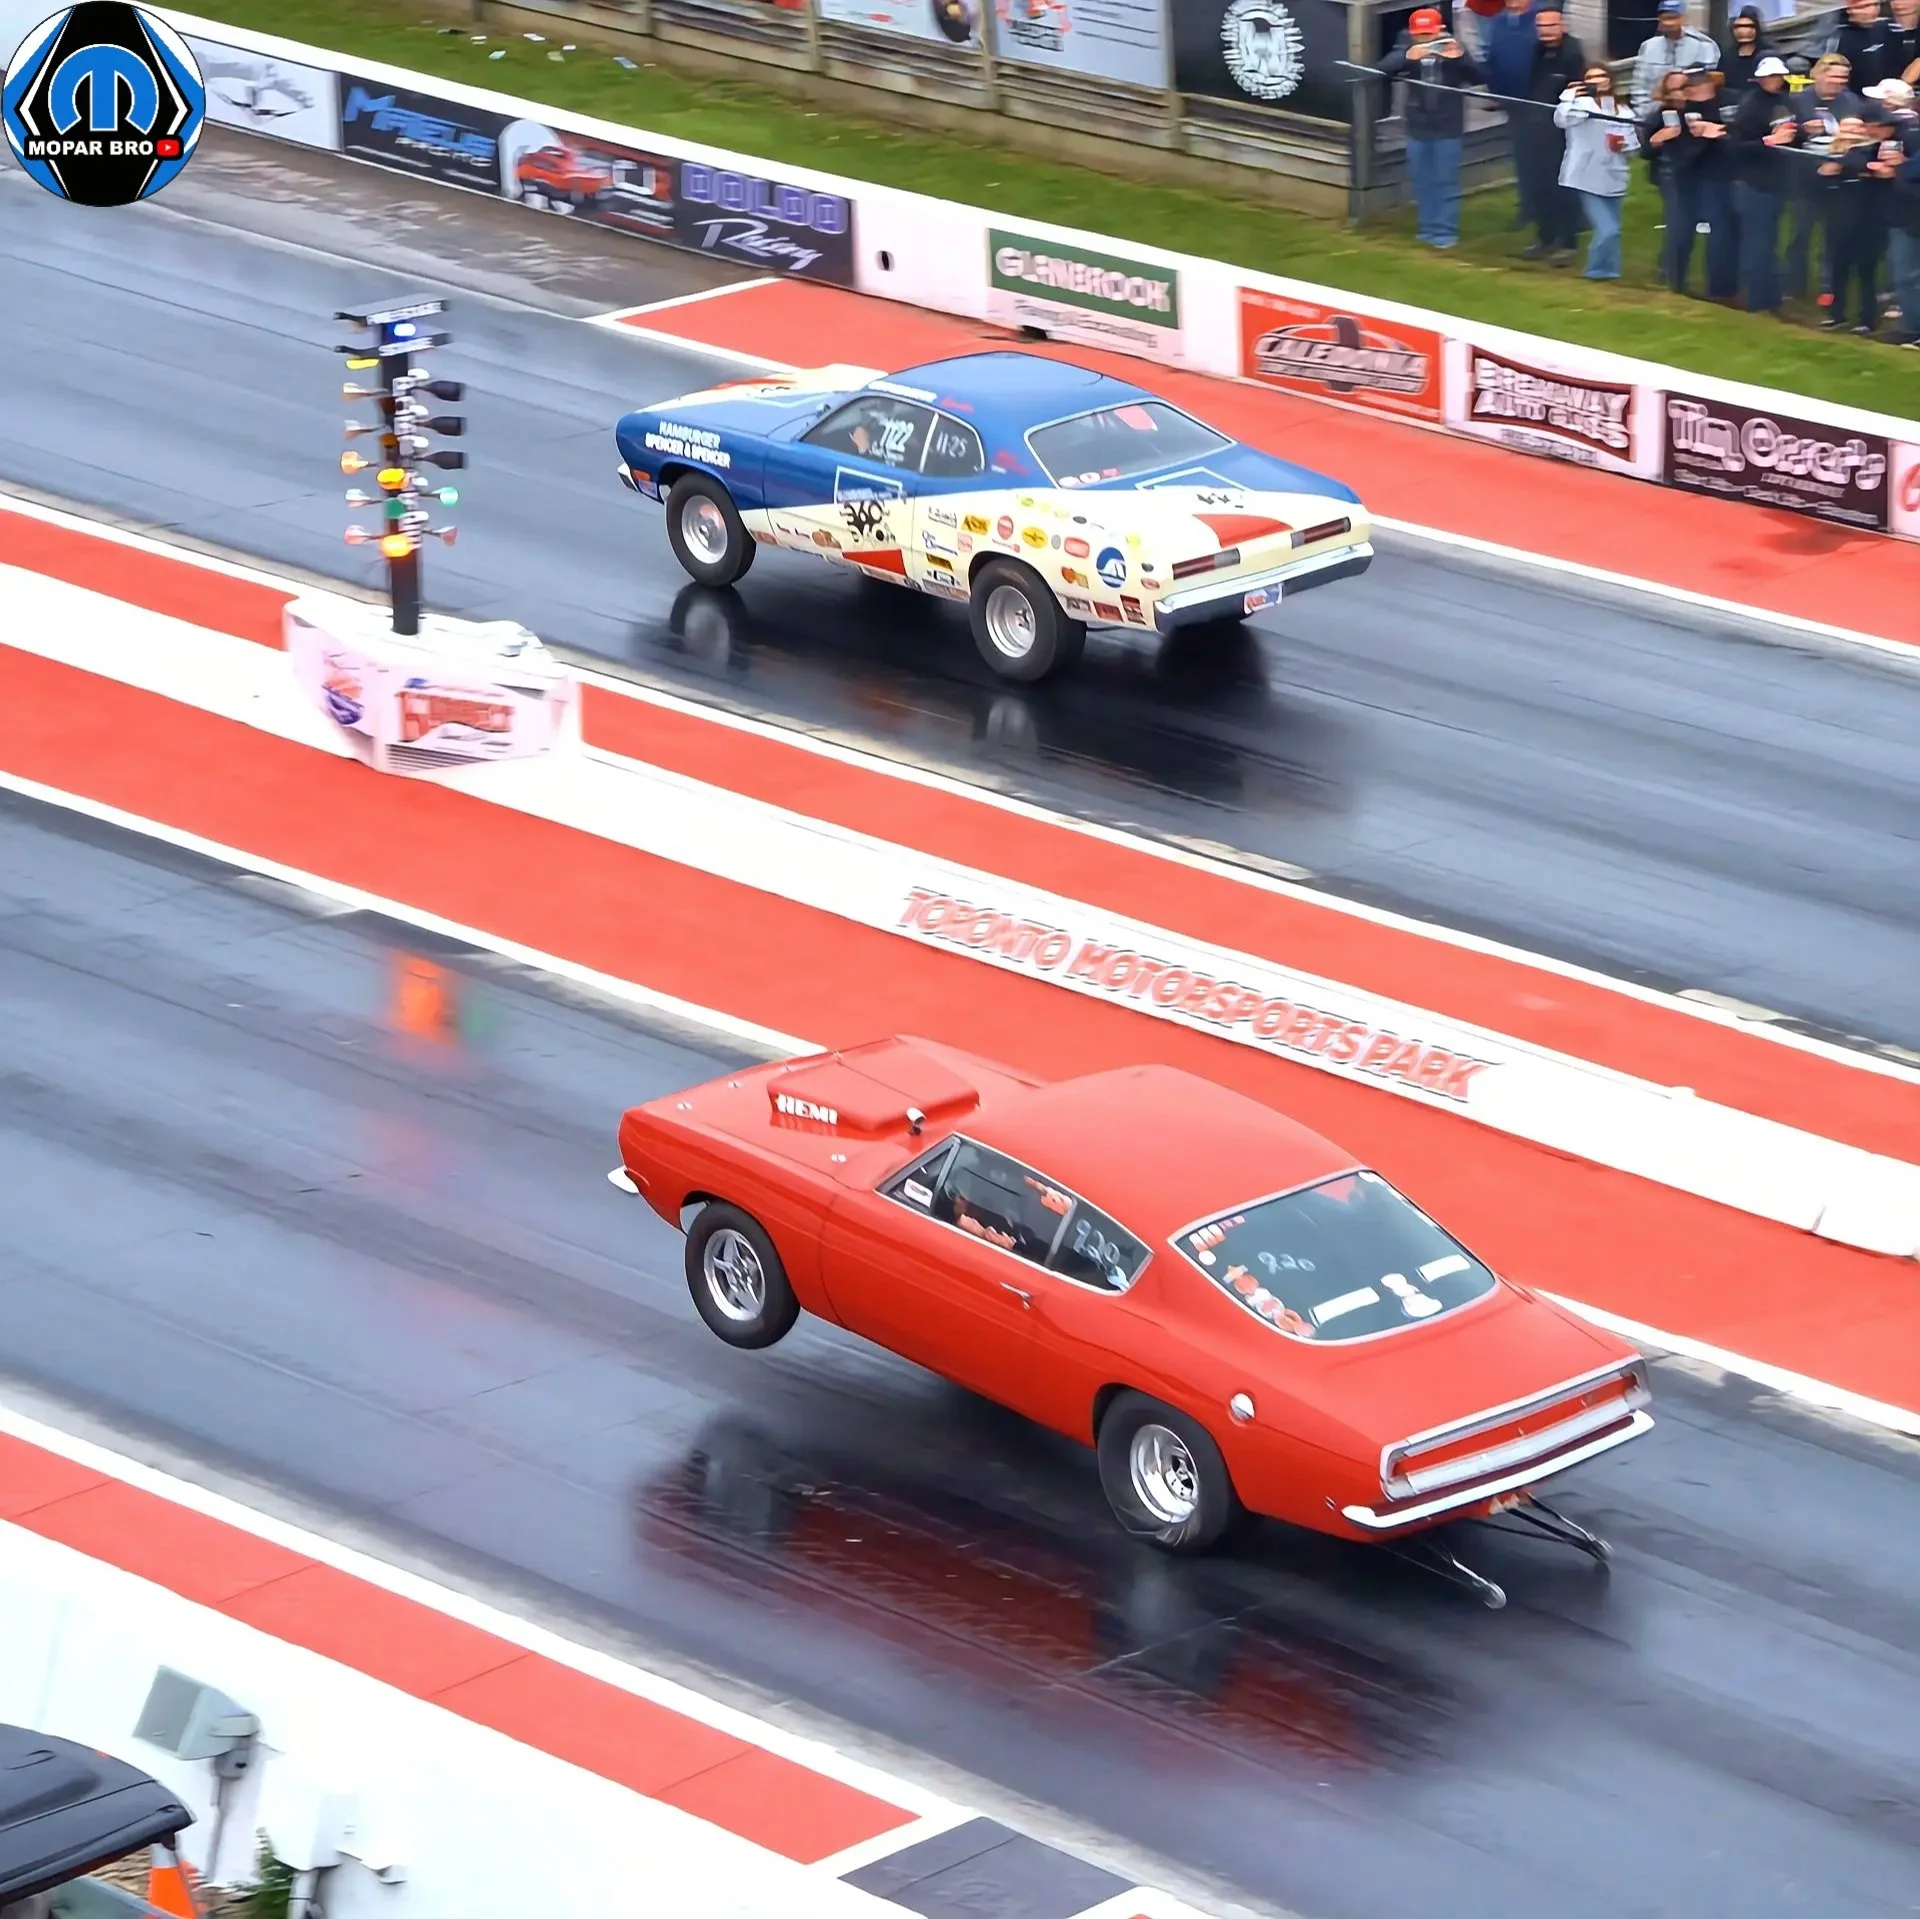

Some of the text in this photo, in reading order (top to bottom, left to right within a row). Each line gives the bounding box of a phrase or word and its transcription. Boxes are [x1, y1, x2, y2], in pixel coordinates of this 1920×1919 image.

[899, 890, 1488, 1098] TORONTO MOTORSPORTS PARK
[776, 1093, 838, 1126] HEMI
